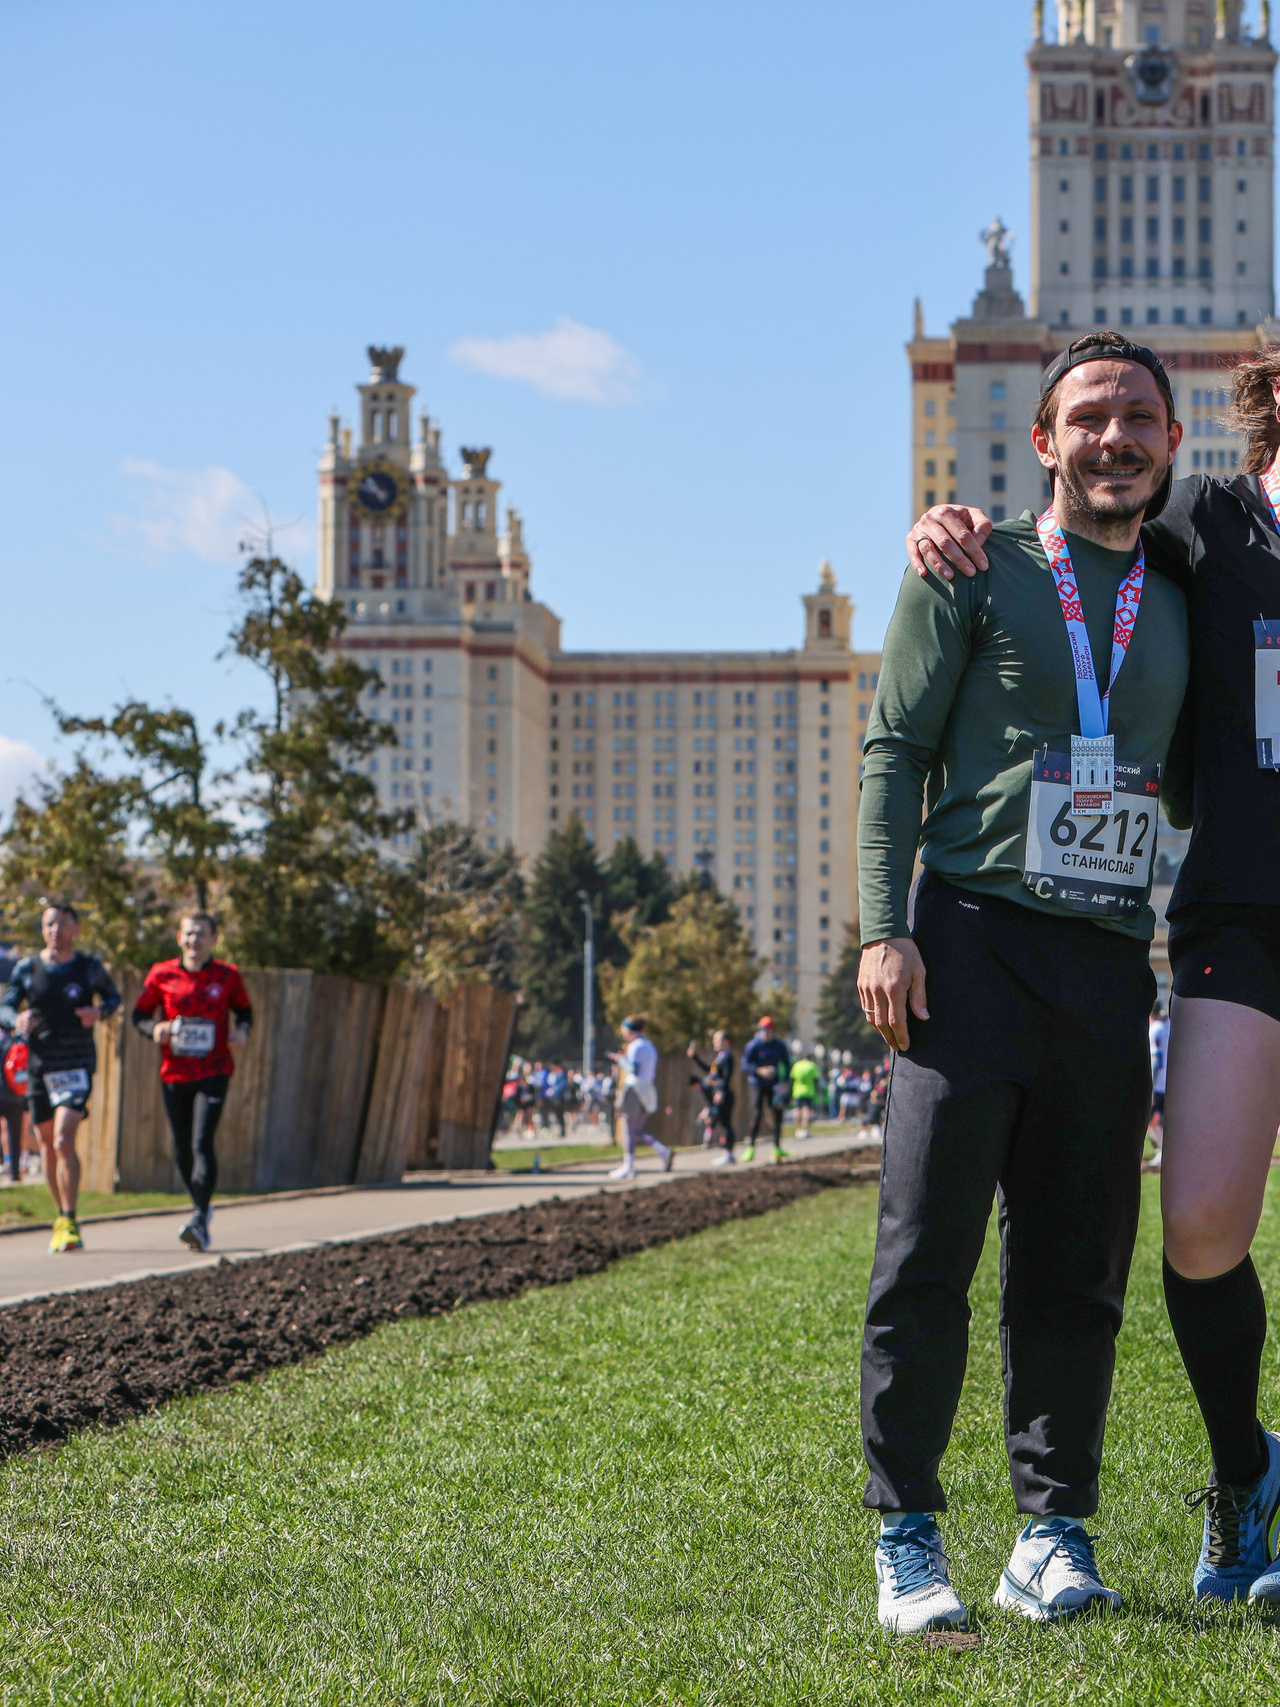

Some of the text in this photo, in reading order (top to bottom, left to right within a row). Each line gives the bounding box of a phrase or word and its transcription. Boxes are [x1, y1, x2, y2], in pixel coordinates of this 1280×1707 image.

[1069, 631, 1083, 679] МОСКОВСКИЙ
[1084, 645, 1094, 680] МАРАФОН
[1043, 769, 1070, 780] 202
[1114, 765, 1141, 775] ОВСКИЙ
[1049, 801, 1149, 857] 6212
[1061, 852, 1135, 875] СТАНИСЛАВ
